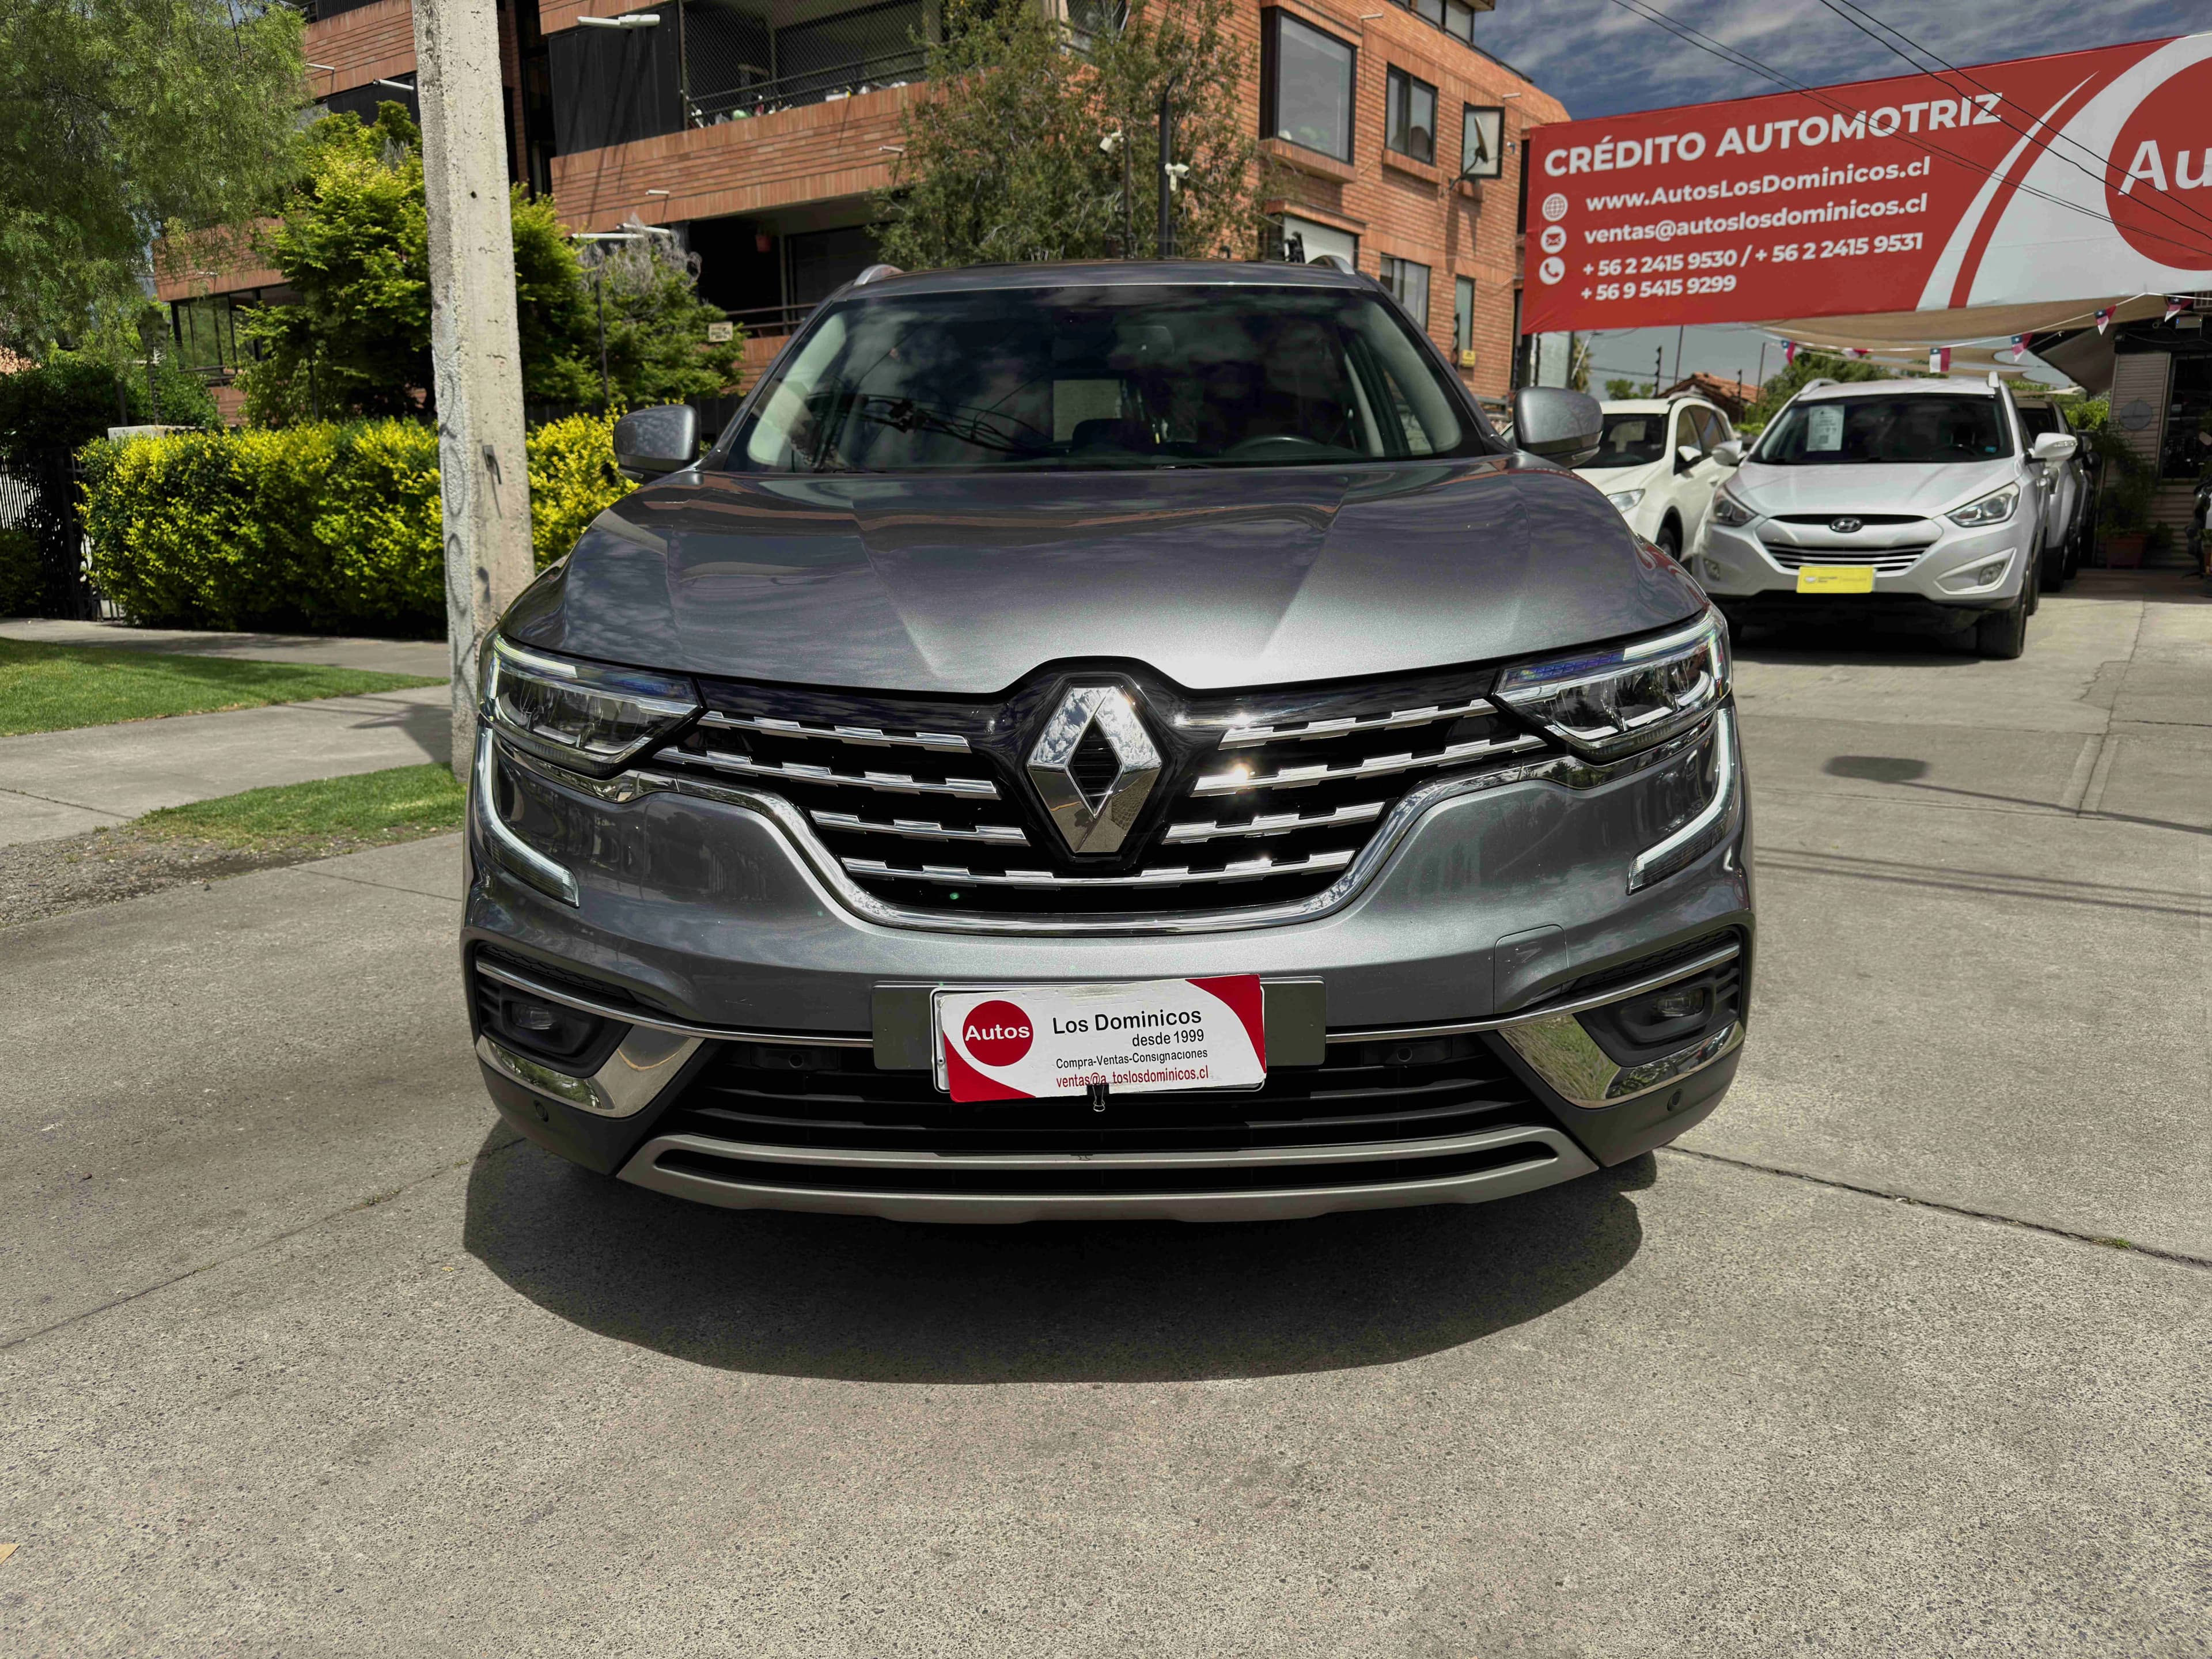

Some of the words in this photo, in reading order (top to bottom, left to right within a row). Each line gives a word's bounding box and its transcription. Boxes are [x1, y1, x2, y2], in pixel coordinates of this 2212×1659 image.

[1544, 132, 1706, 177] CRÉDITO
[1715, 92, 2003, 157] AUTOMOTRIZ
[1586, 156, 1930, 211] www.AutosLosDominicos.cl
[1585, 192, 1927, 244] ventas@autoslosdominicos.cl
[1583, 263, 1594, 275] +
[1597, 258, 1622, 276] 56
[1625, 257, 1637, 274] 2
[1641, 253, 1684, 273] 2415
[1687, 249, 1737, 270] 9530
[1740, 244, 1753, 267] /
[1755, 249, 1767, 262] +
[1771, 244, 1798, 262] 56
[1802, 243, 1816, 260] 2
[1820, 237, 1869, 258] 2415
[1873, 232, 1923, 253] 9531
[1581, 287, 1592, 300] +
[1595, 283, 1620, 301] 56
[1623, 282, 1635, 299] 9
[1639, 278, 1683, 297] 5415
[1687, 274, 1737, 294] 9299
[965, 1024, 1030, 1041] Autos
[1053, 1017, 1089, 1034] Los
[1095, 1009, 1202, 1031] Dominicos
[1132, 1032, 1171, 1047] desde
[1173, 1029, 1204, 1043] 1999
[1056, 1050, 1208, 1070] Compra-Ventas-Consignaciones
[1056, 1065, 1209, 1088] ventas@atoslosdominicos.cl
